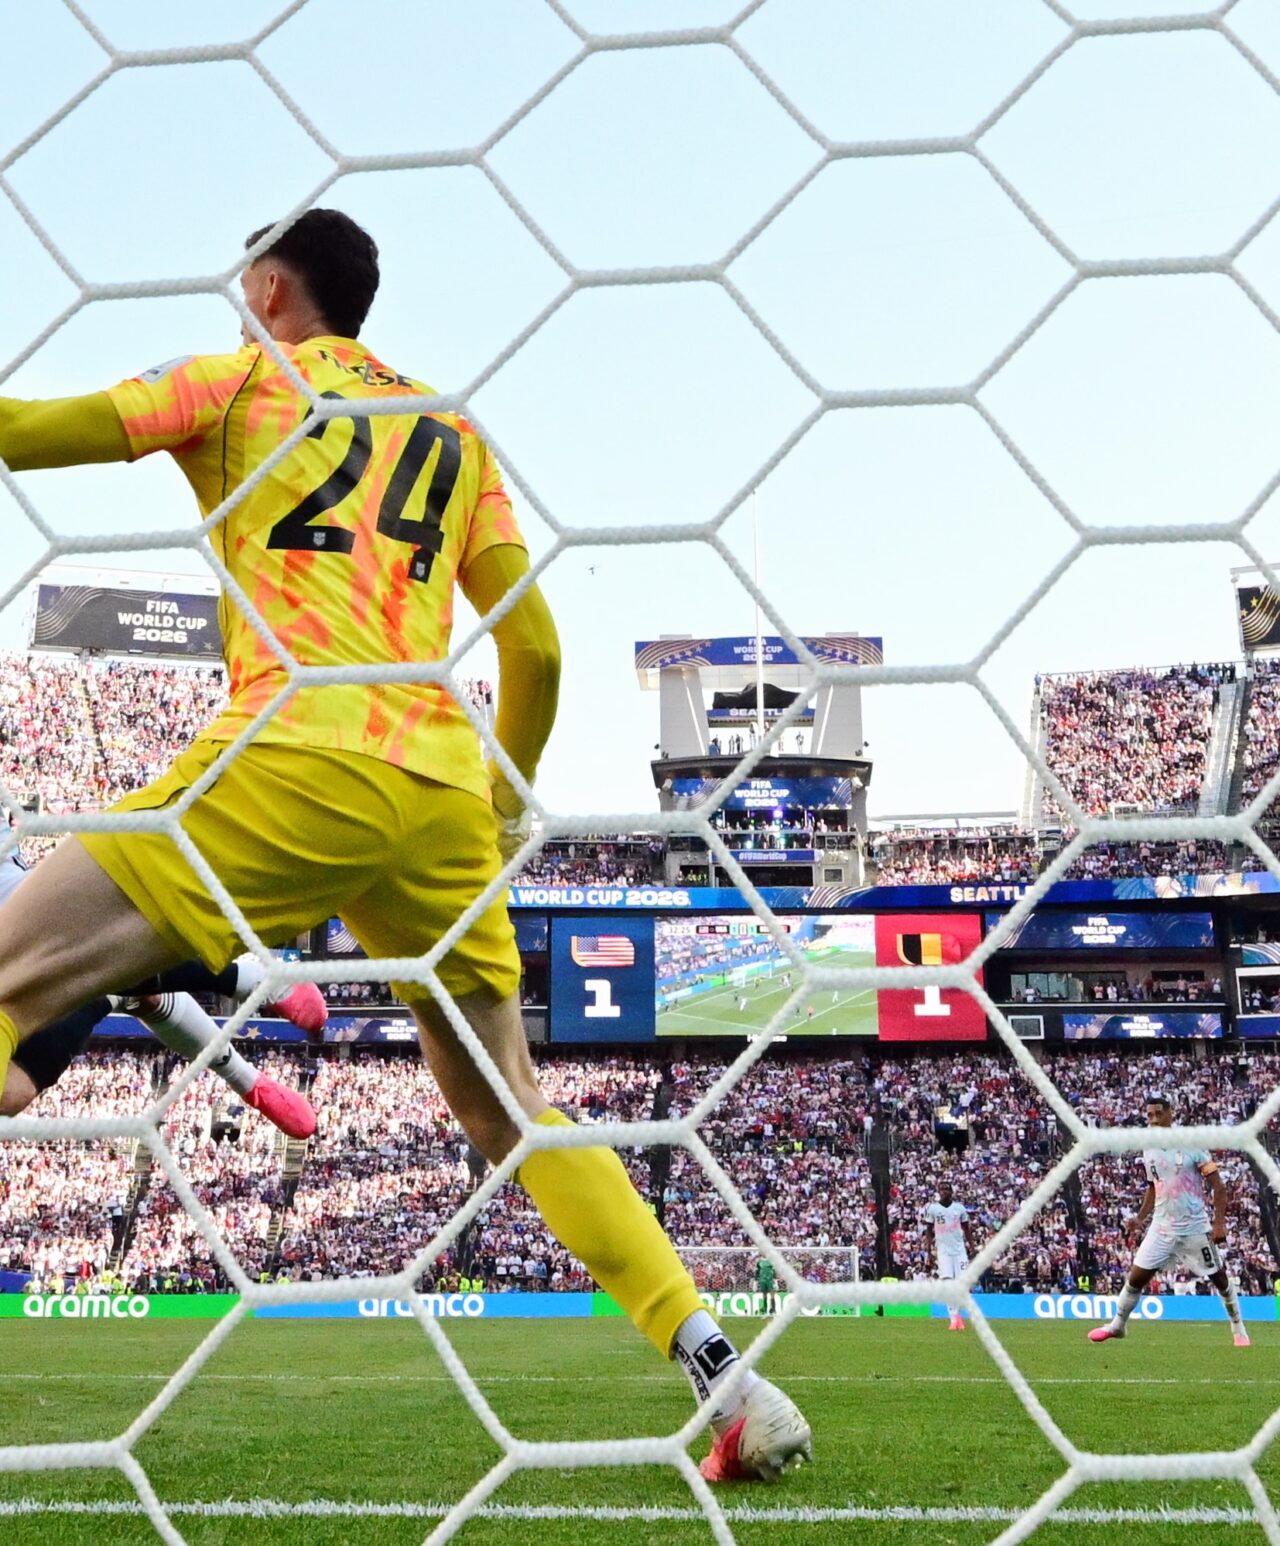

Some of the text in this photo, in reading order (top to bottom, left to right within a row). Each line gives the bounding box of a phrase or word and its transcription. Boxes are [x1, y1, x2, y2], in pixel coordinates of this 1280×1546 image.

[266, 391, 461, 584] 24
[146, 600, 179, 614] FIFA
[117, 612, 208, 630] WORLD CUP
[133, 627, 188, 644] 2026
[748, 638, 767, 646] FIA
[743, 654, 774, 662] 206
[765, 646, 784, 654] CUP
[734, 789, 790, 798] WORLD CUP
[751, 780, 773, 790] FIFA
[518, 889, 584, 905] WORLD
[586, 890, 624, 905] CUP
[625, 890, 690, 906] 2026
[584, 979, 621, 1017] 1
[914, 980, 951, 1016] 1
[24, 1294, 150, 1318] aramco
[1034, 1294, 1164, 1319] aramo
